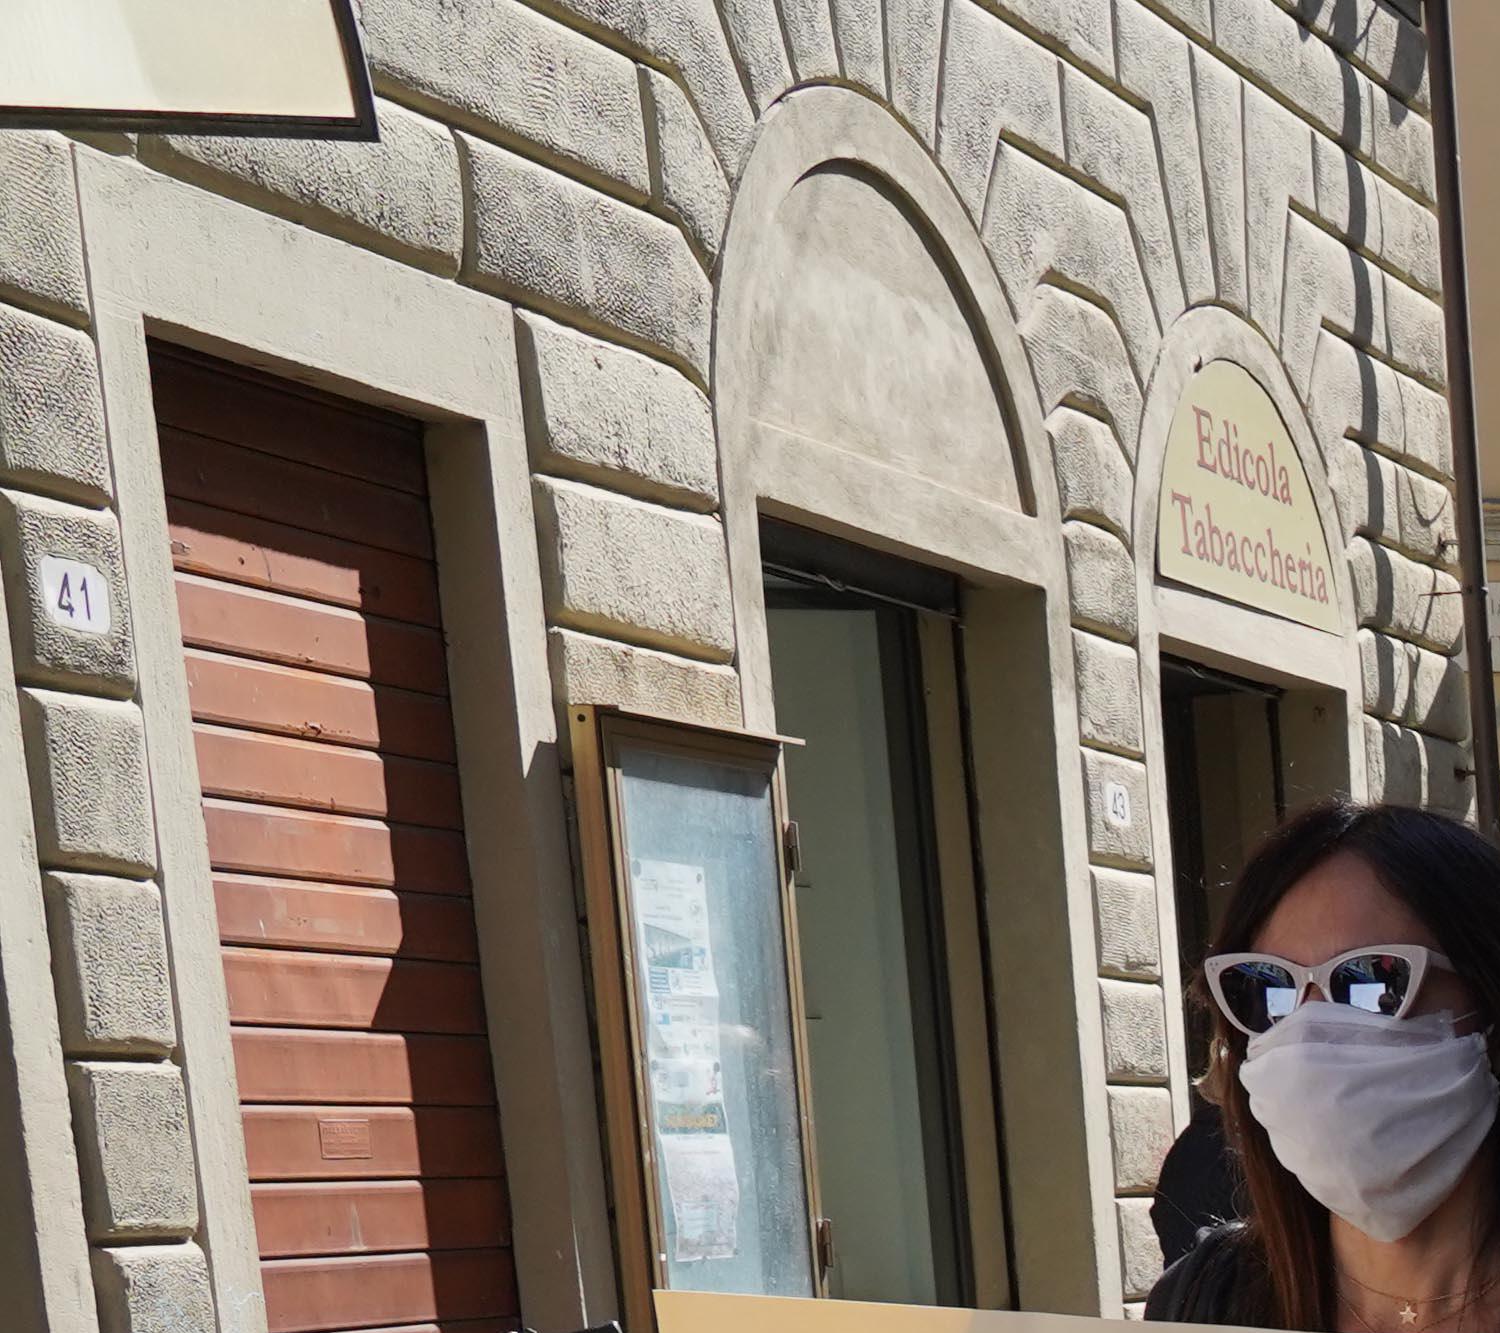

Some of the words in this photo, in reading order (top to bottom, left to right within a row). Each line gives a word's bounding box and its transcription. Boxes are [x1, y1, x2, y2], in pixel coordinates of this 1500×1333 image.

[1192, 404, 1292, 506] Edicola
[1171, 489, 1329, 604] Tabaccheria
[58, 572, 91, 621] 41
[1112, 791, 1127, 820] 43
